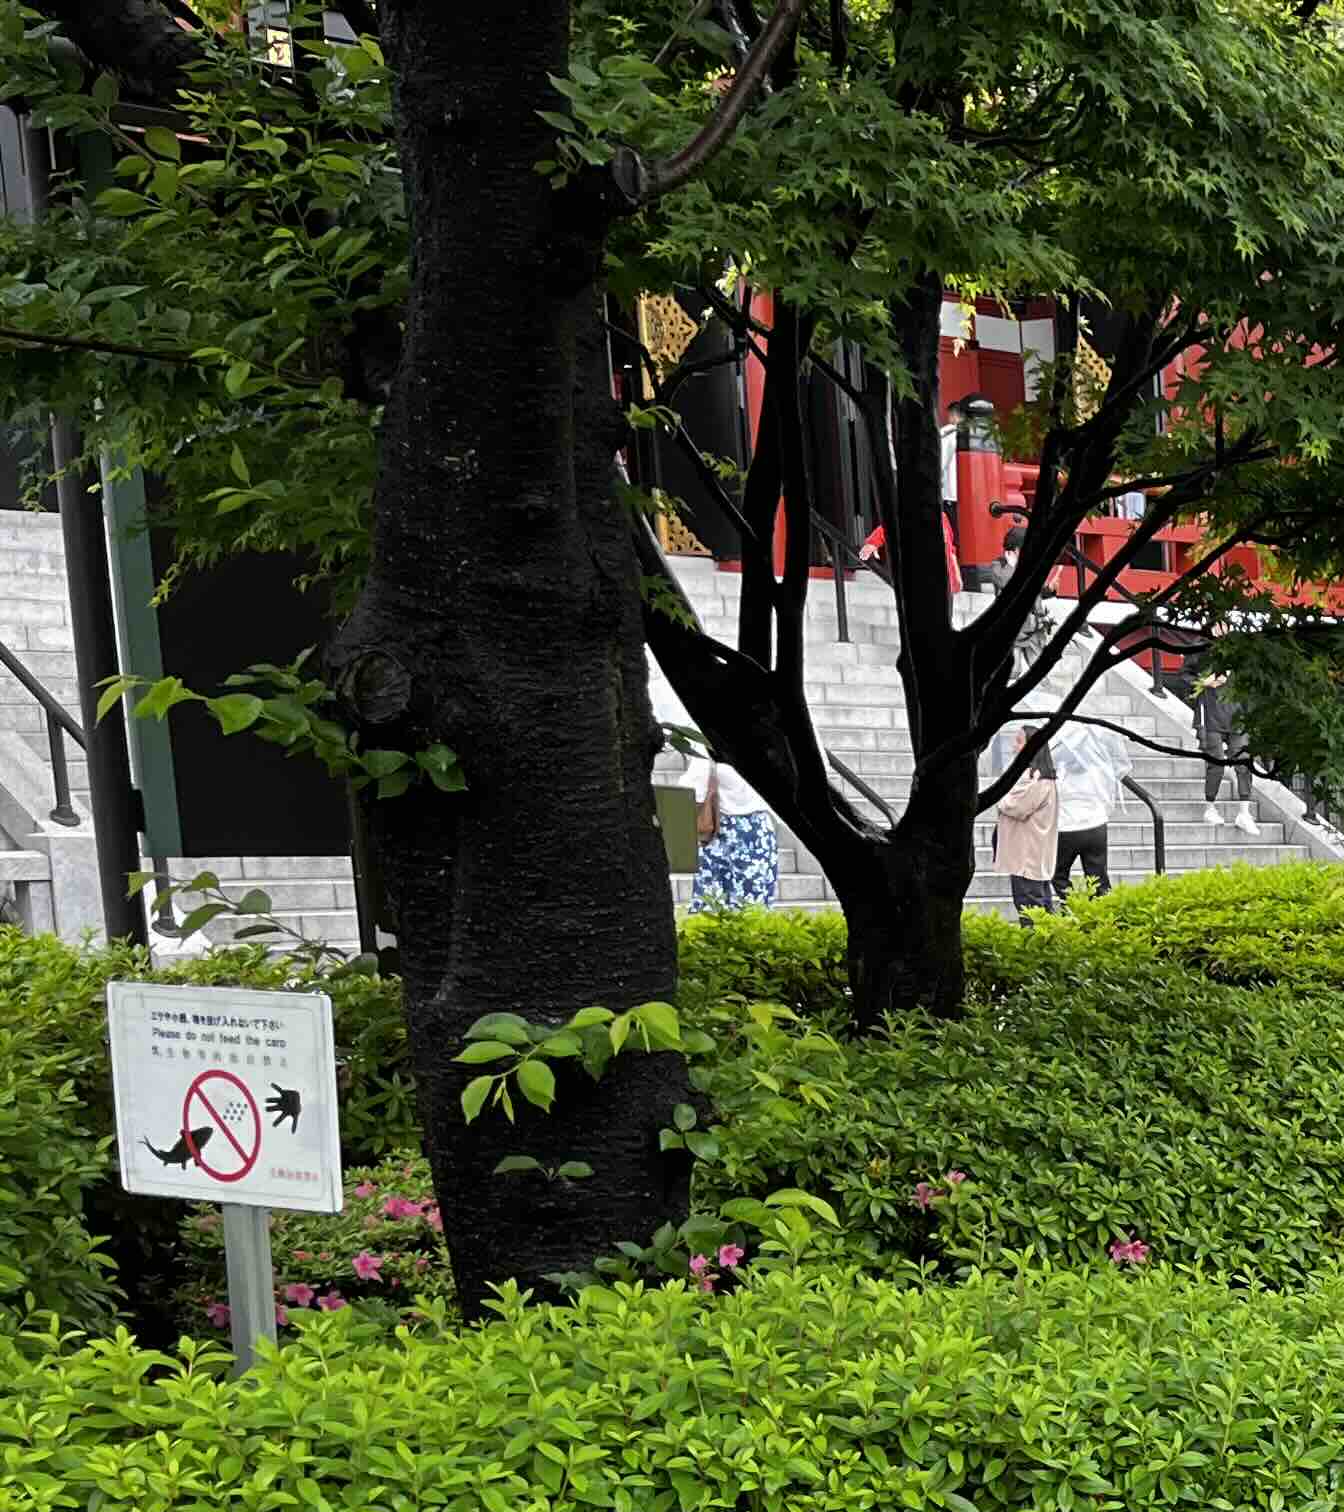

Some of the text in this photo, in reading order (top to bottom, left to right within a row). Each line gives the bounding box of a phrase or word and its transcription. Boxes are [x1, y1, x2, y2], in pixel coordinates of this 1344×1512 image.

[151, 1027, 181, 1039] Please
[185, 1031, 197, 1041] do
[200, 1032, 215, 1043] not
[219, 1034, 241, 1045] feed
[245, 1035, 260, 1046] the
